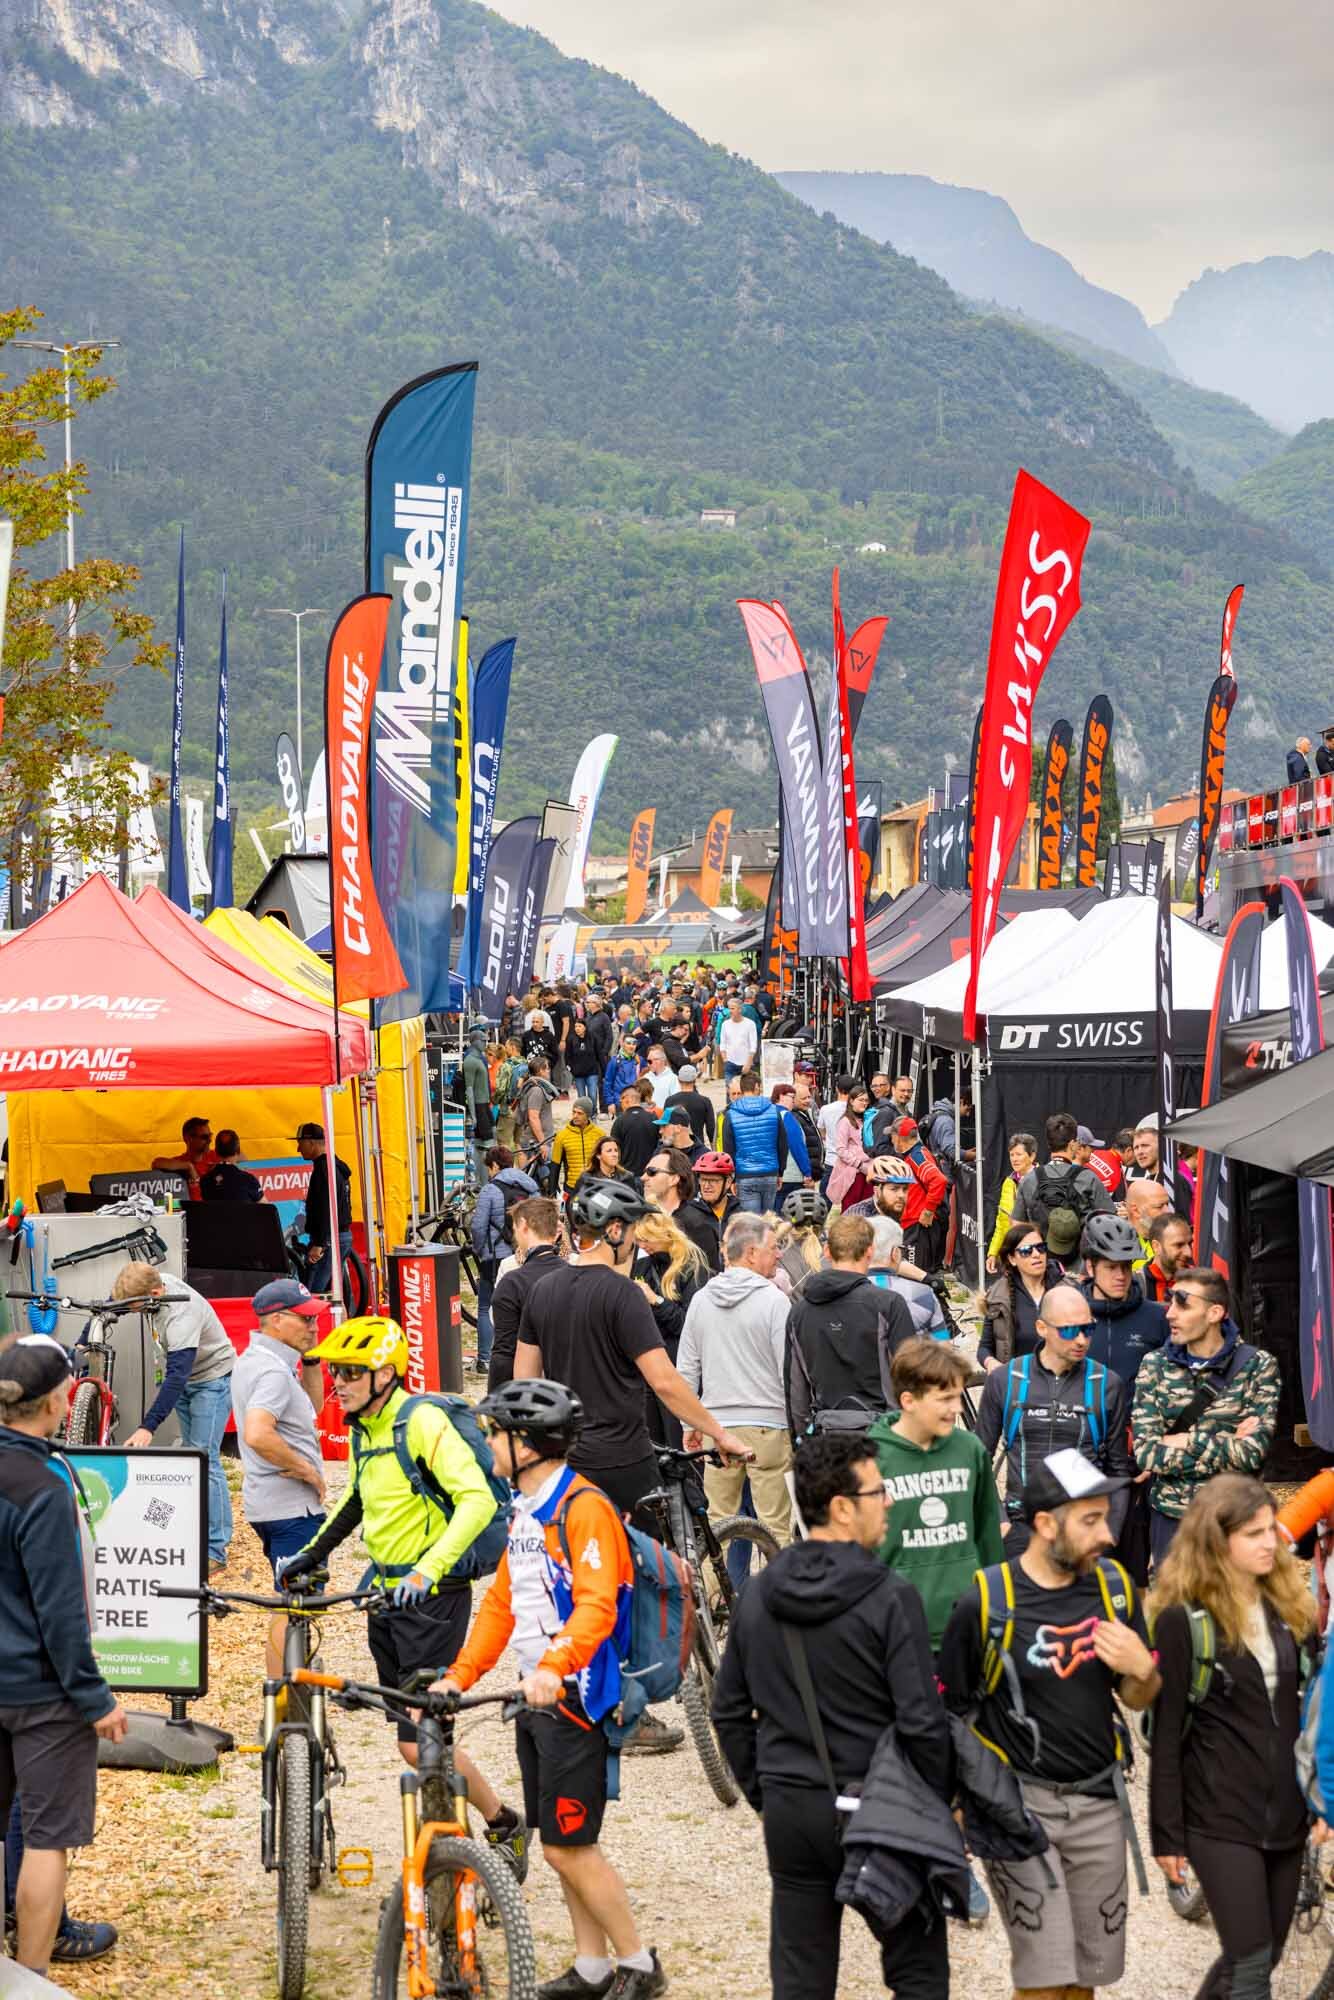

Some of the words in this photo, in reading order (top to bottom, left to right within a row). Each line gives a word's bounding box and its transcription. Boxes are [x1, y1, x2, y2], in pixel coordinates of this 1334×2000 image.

[450, 494, 460, 530] 1945
[375, 483, 448, 818] Mandelli
[488, 747, 501, 797] NATURE
[342, 655, 372, 956] CHAOYANG
[484, 798, 495, 833] YOUR
[1040, 740, 1069, 889] MAXXIS
[1079, 719, 1107, 888] MAXXIS
[477, 834, 490, 893] UNLEASH
[634, 822, 651, 872] KTM
[708, 821, 727, 872] KTM
[999, 1024, 1050, 1049] DT
[1056, 1020, 1145, 1049] SWISS
[88, 1070, 128, 1082] TIRES
[423, 1273, 431, 1304] TIRES
[403, 1265, 425, 1394] CHAOYANG
[136, 1473, 193, 1483] BIKEGROOVY
[883, 1468, 971, 1501] RANGELEY
[902, 1522, 968, 1548] LAKERS
[113, 1546, 185, 1567] WASH
[120, 1665, 144, 1676] BIKE
